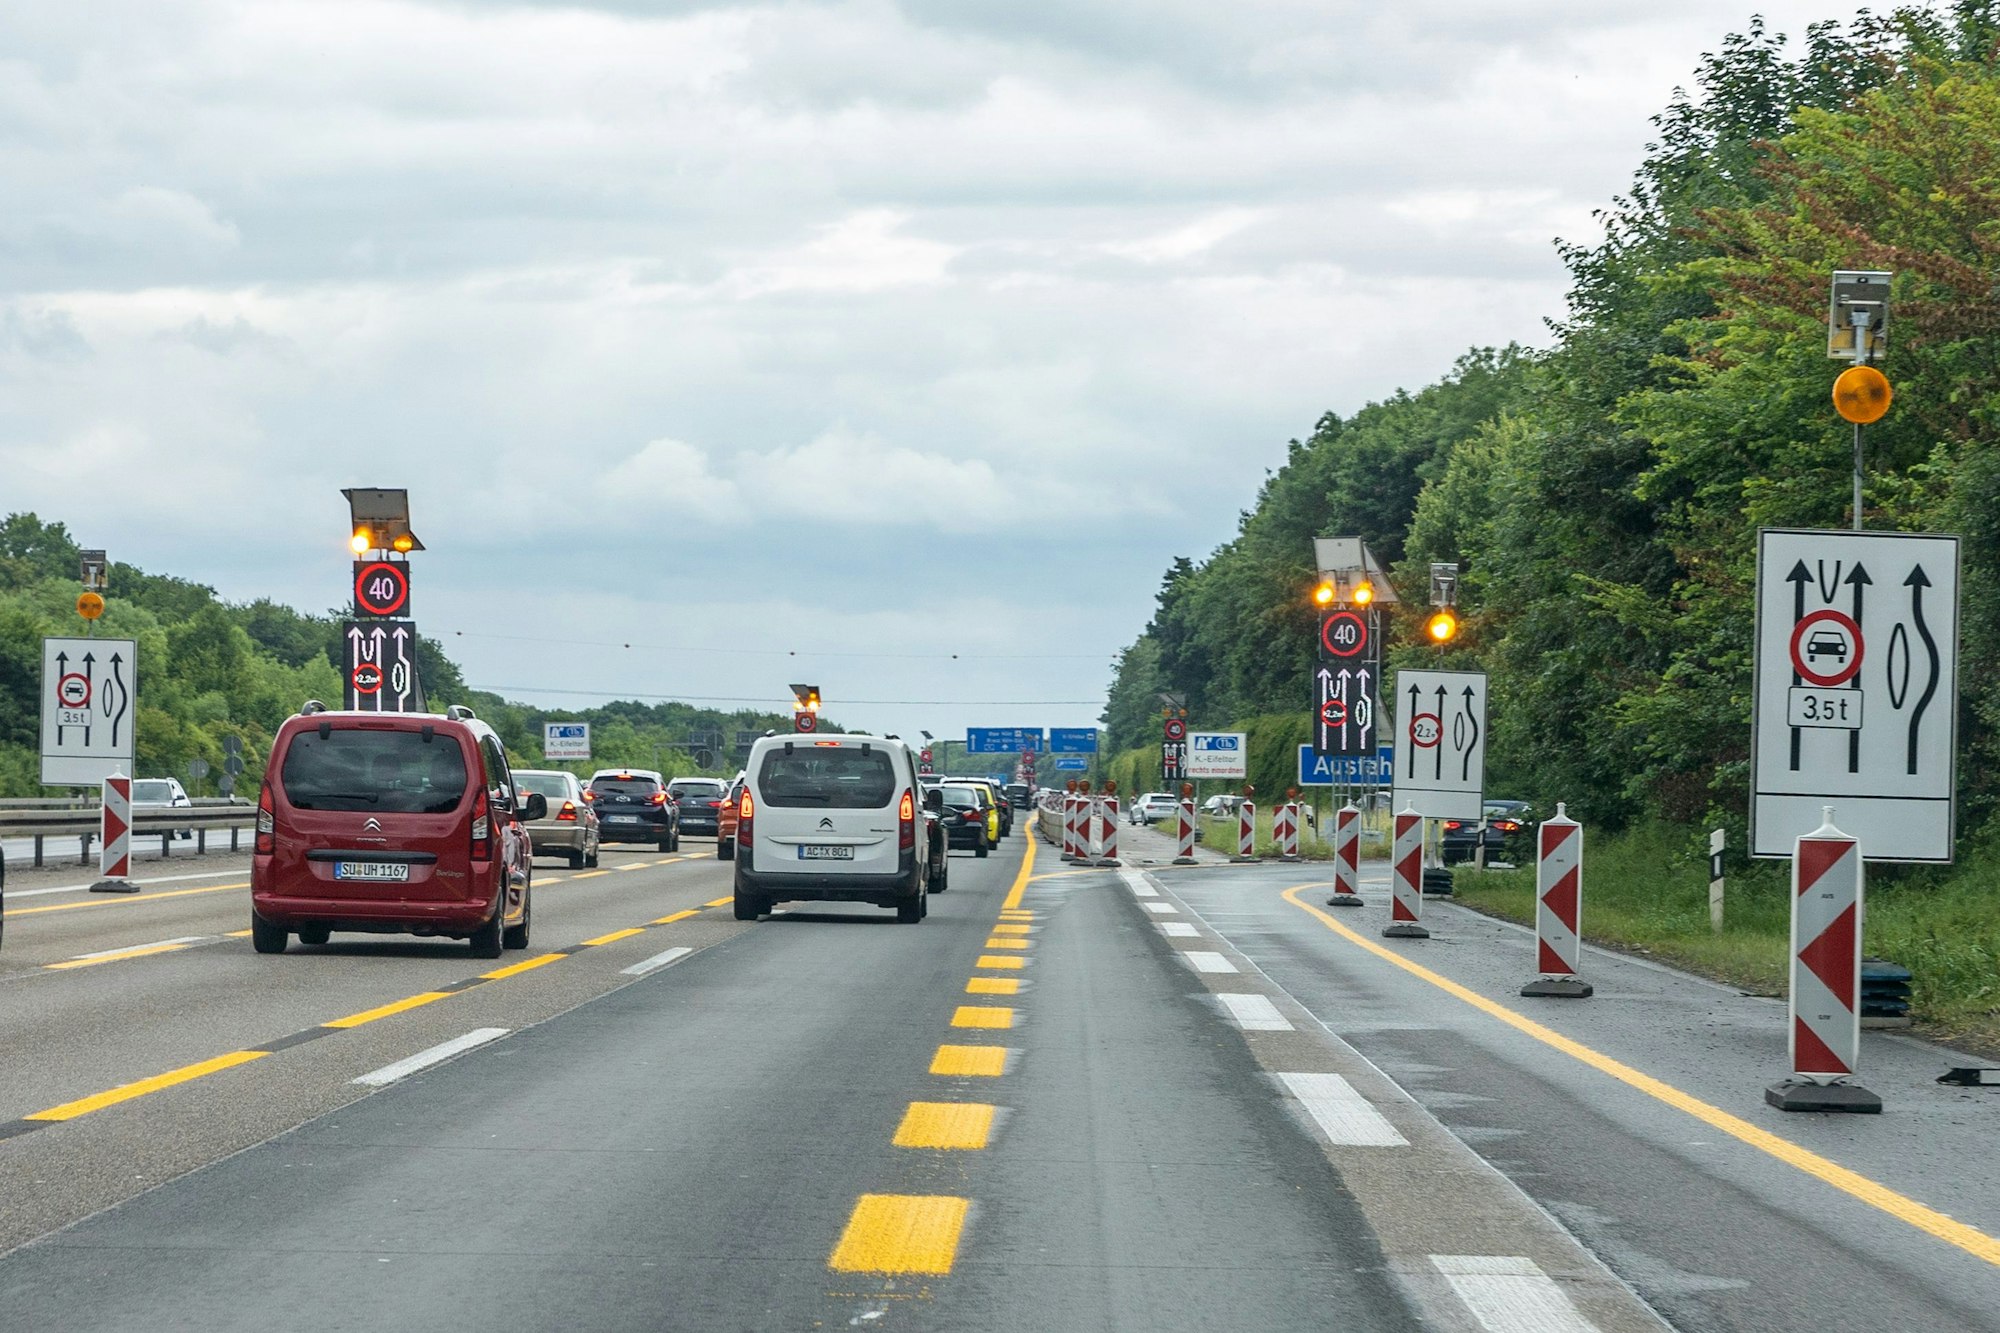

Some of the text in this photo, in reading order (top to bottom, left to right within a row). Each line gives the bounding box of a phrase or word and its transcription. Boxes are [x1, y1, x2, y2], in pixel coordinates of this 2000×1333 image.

[369, 577, 394, 600] 40
[1334, 624, 1356, 645] 40
[1803, 695, 1848, 721] 3,5 t
[1188, 766, 1244, 774] rechts einordnen
[1313, 755, 1393, 775] Ausfah
[807, 847, 849, 857] AC X 801
[342, 863, 407, 876] SU UH 1167
